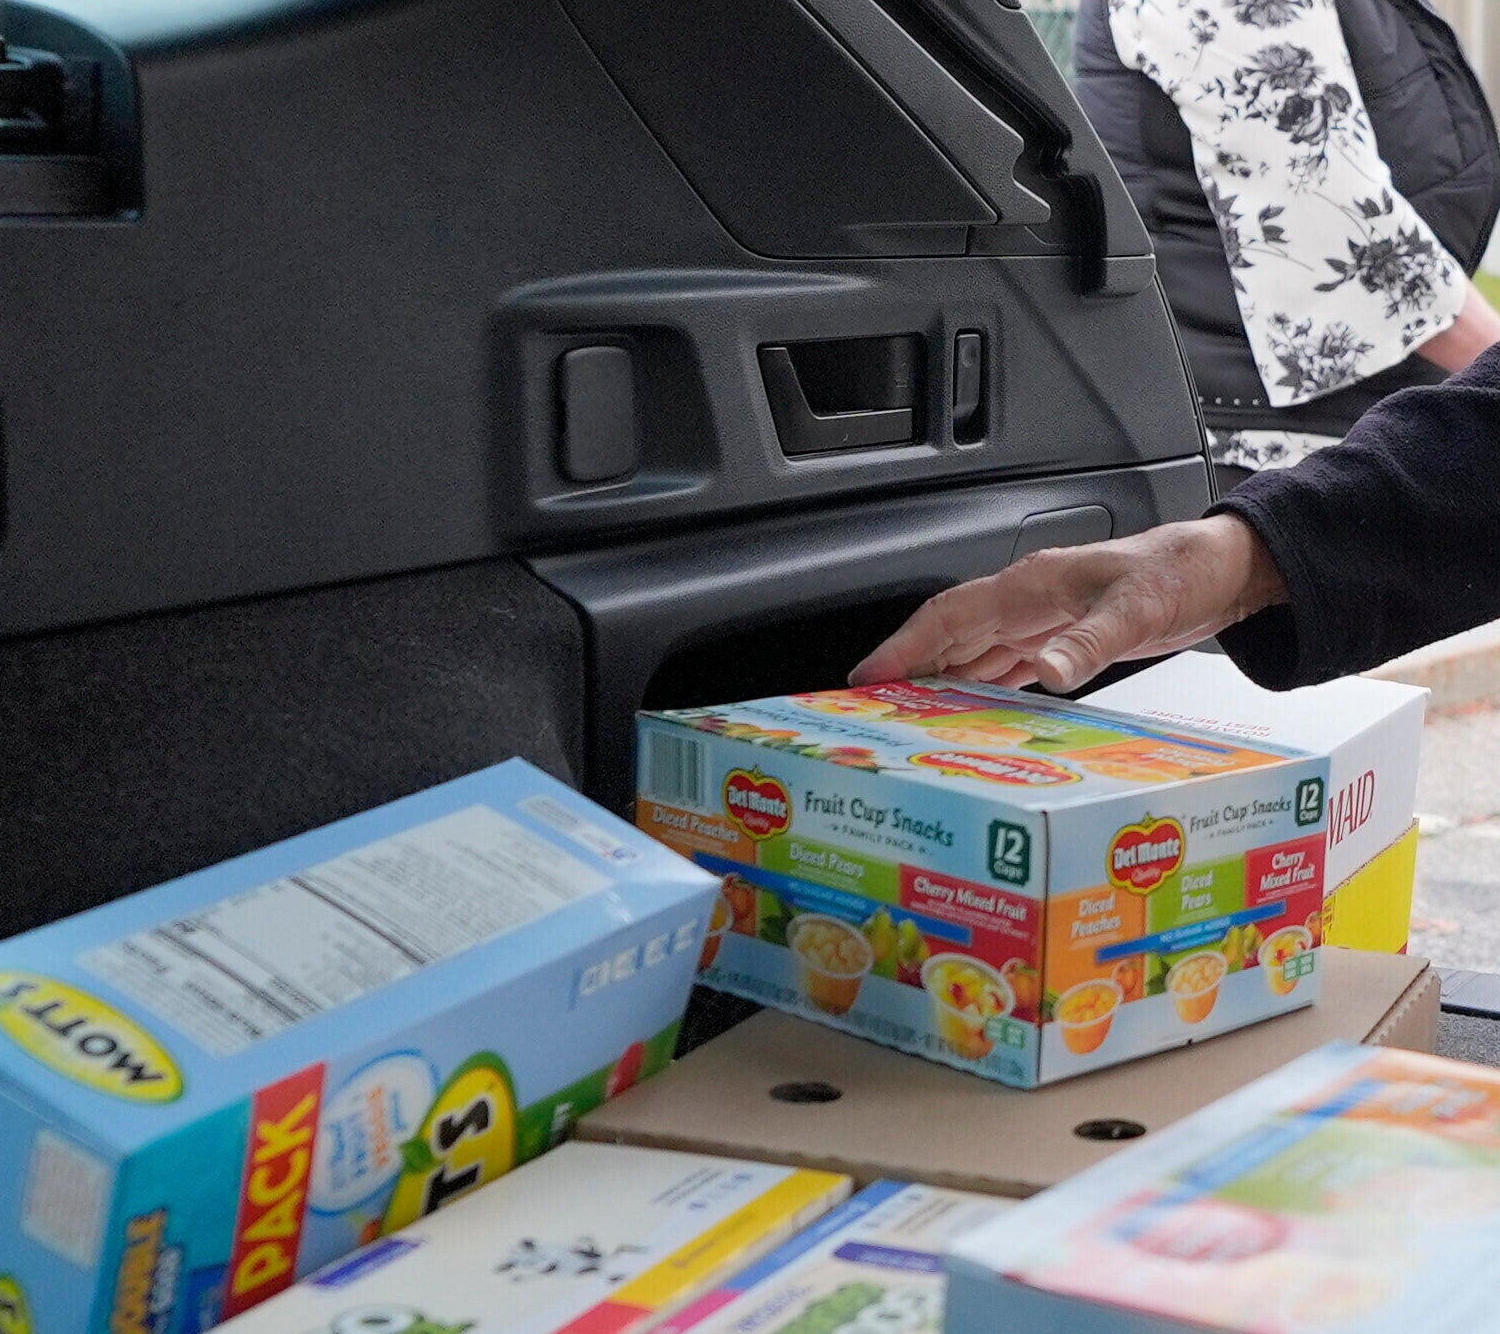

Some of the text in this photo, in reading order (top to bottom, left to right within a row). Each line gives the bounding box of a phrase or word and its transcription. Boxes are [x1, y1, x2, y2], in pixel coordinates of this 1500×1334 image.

[727, 785, 788, 819] Del Monte
[1300, 782, 1319, 810] 12
[1329, 769, 1375, 851] MAID
[652, 806, 740, 845] Diced Peaches
[804, 791, 955, 848] Fruit Cup Snacks
[1190, 797, 1291, 833] Fruit Cup Snacks
[790, 844, 865, 878] Diced Pears
[995, 827, 1026, 865] 12
[1114, 838, 1180, 869] Del Monte
[1272, 851, 1305, 871] Cherry
[1180, 871, 1213, 894] Diced
[1260, 865, 1315, 891] Mixed Fruit
[913, 877, 1028, 921] Cherry Mixed Fruit
[1079, 893, 1116, 916] Diced
[1181, 891, 1212, 911] Pears
[1071, 915, 1122, 939] Peaches
[233, 1090, 316, 1295] PACK
